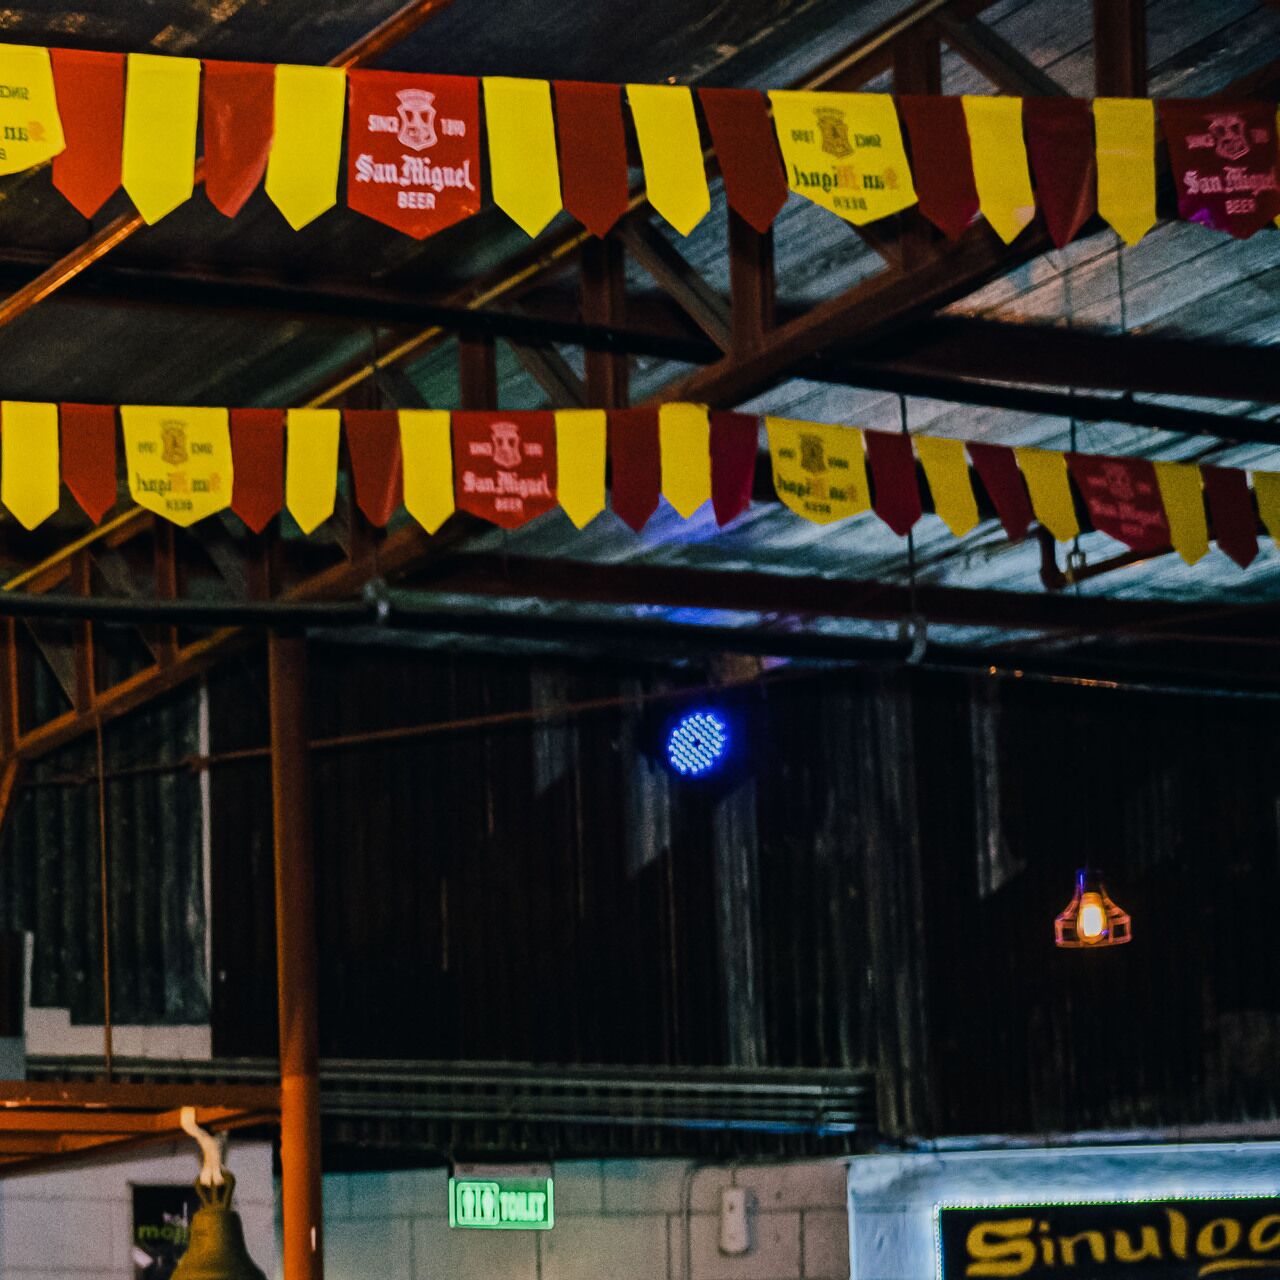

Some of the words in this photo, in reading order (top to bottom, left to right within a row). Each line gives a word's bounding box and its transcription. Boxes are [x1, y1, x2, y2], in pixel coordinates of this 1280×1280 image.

[355, 153, 400, 184] San
[399, 154, 476, 192] Miguel
[1183, 170, 1222, 194] San
[397, 191, 435, 209] BEER
[500, 1192, 546, 1221] TOILET
